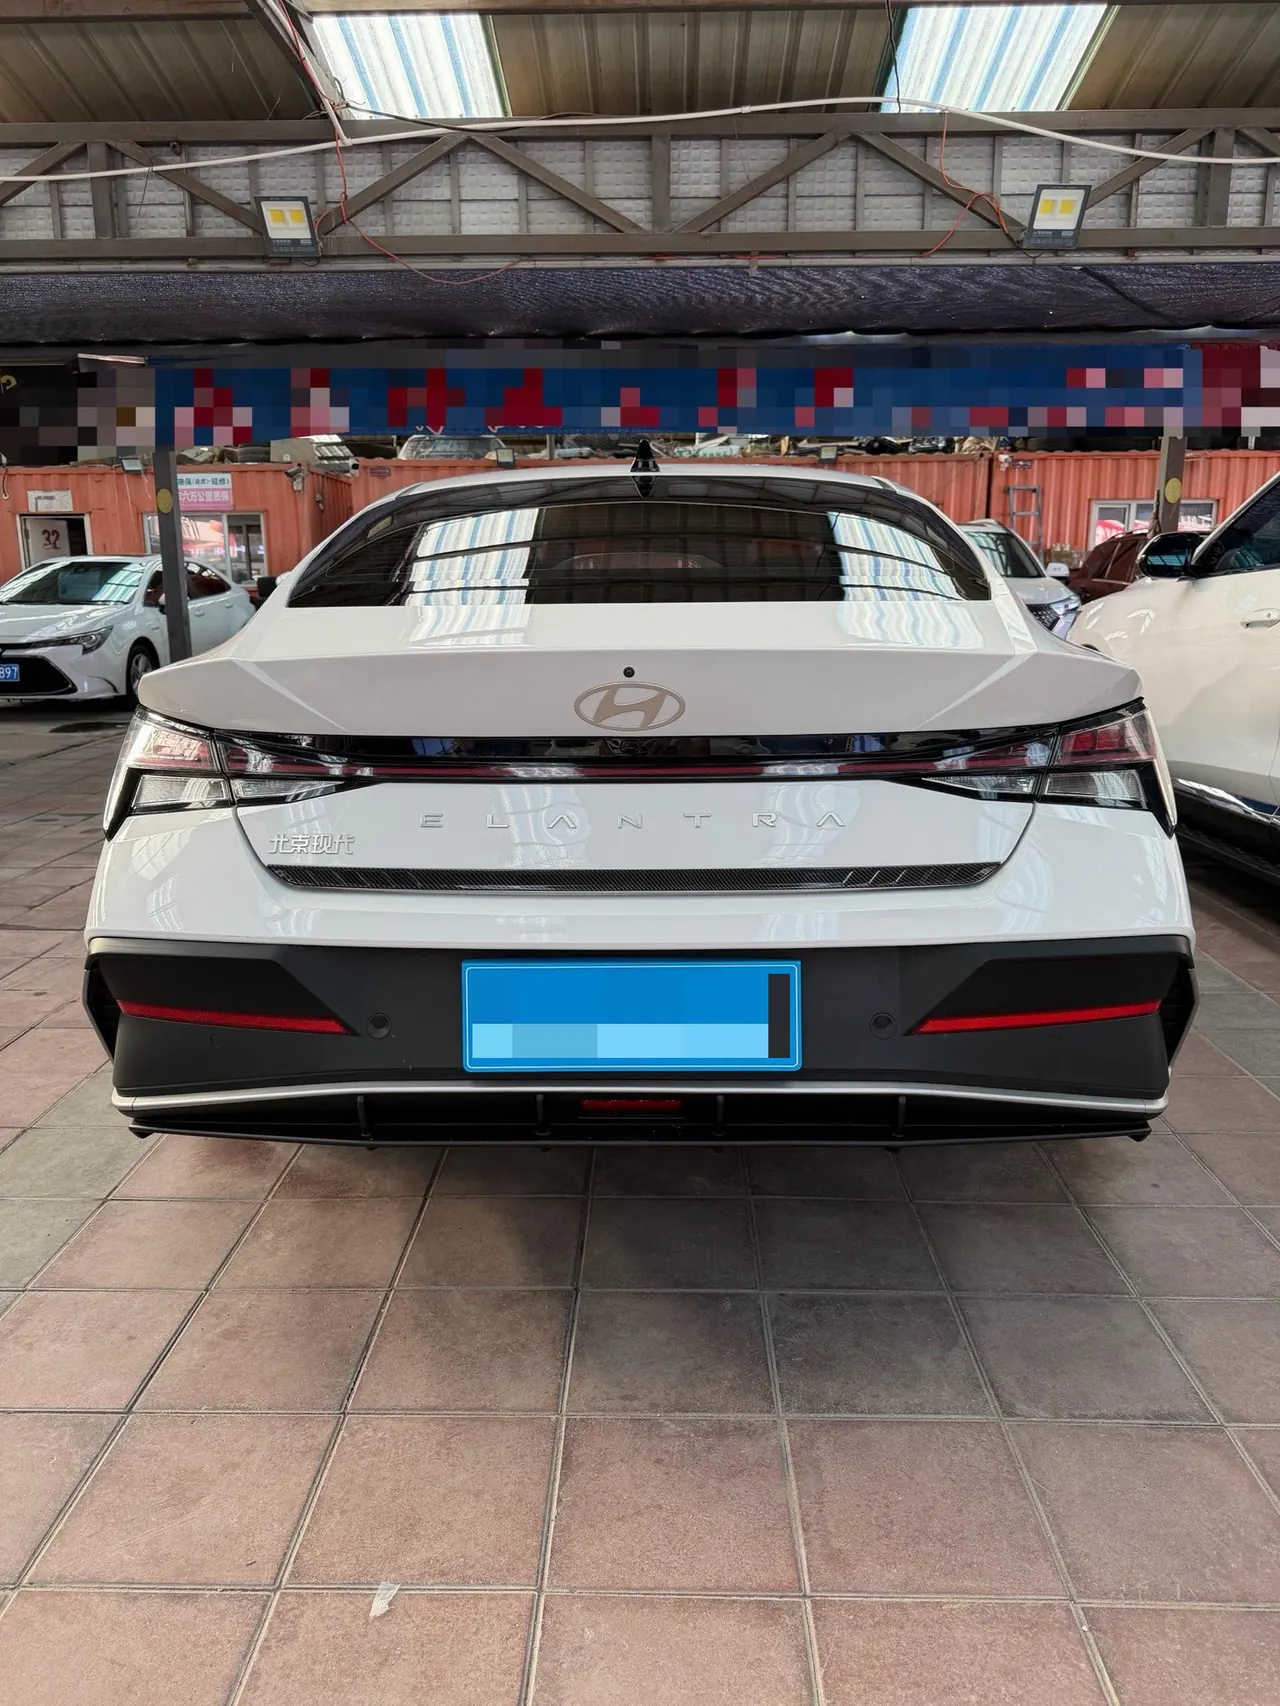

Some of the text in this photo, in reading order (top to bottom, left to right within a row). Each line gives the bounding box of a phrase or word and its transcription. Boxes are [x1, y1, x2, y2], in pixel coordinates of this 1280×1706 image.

[420, 811, 845, 829] ELANTRA
[268, 833, 355, 854] 北京现代
